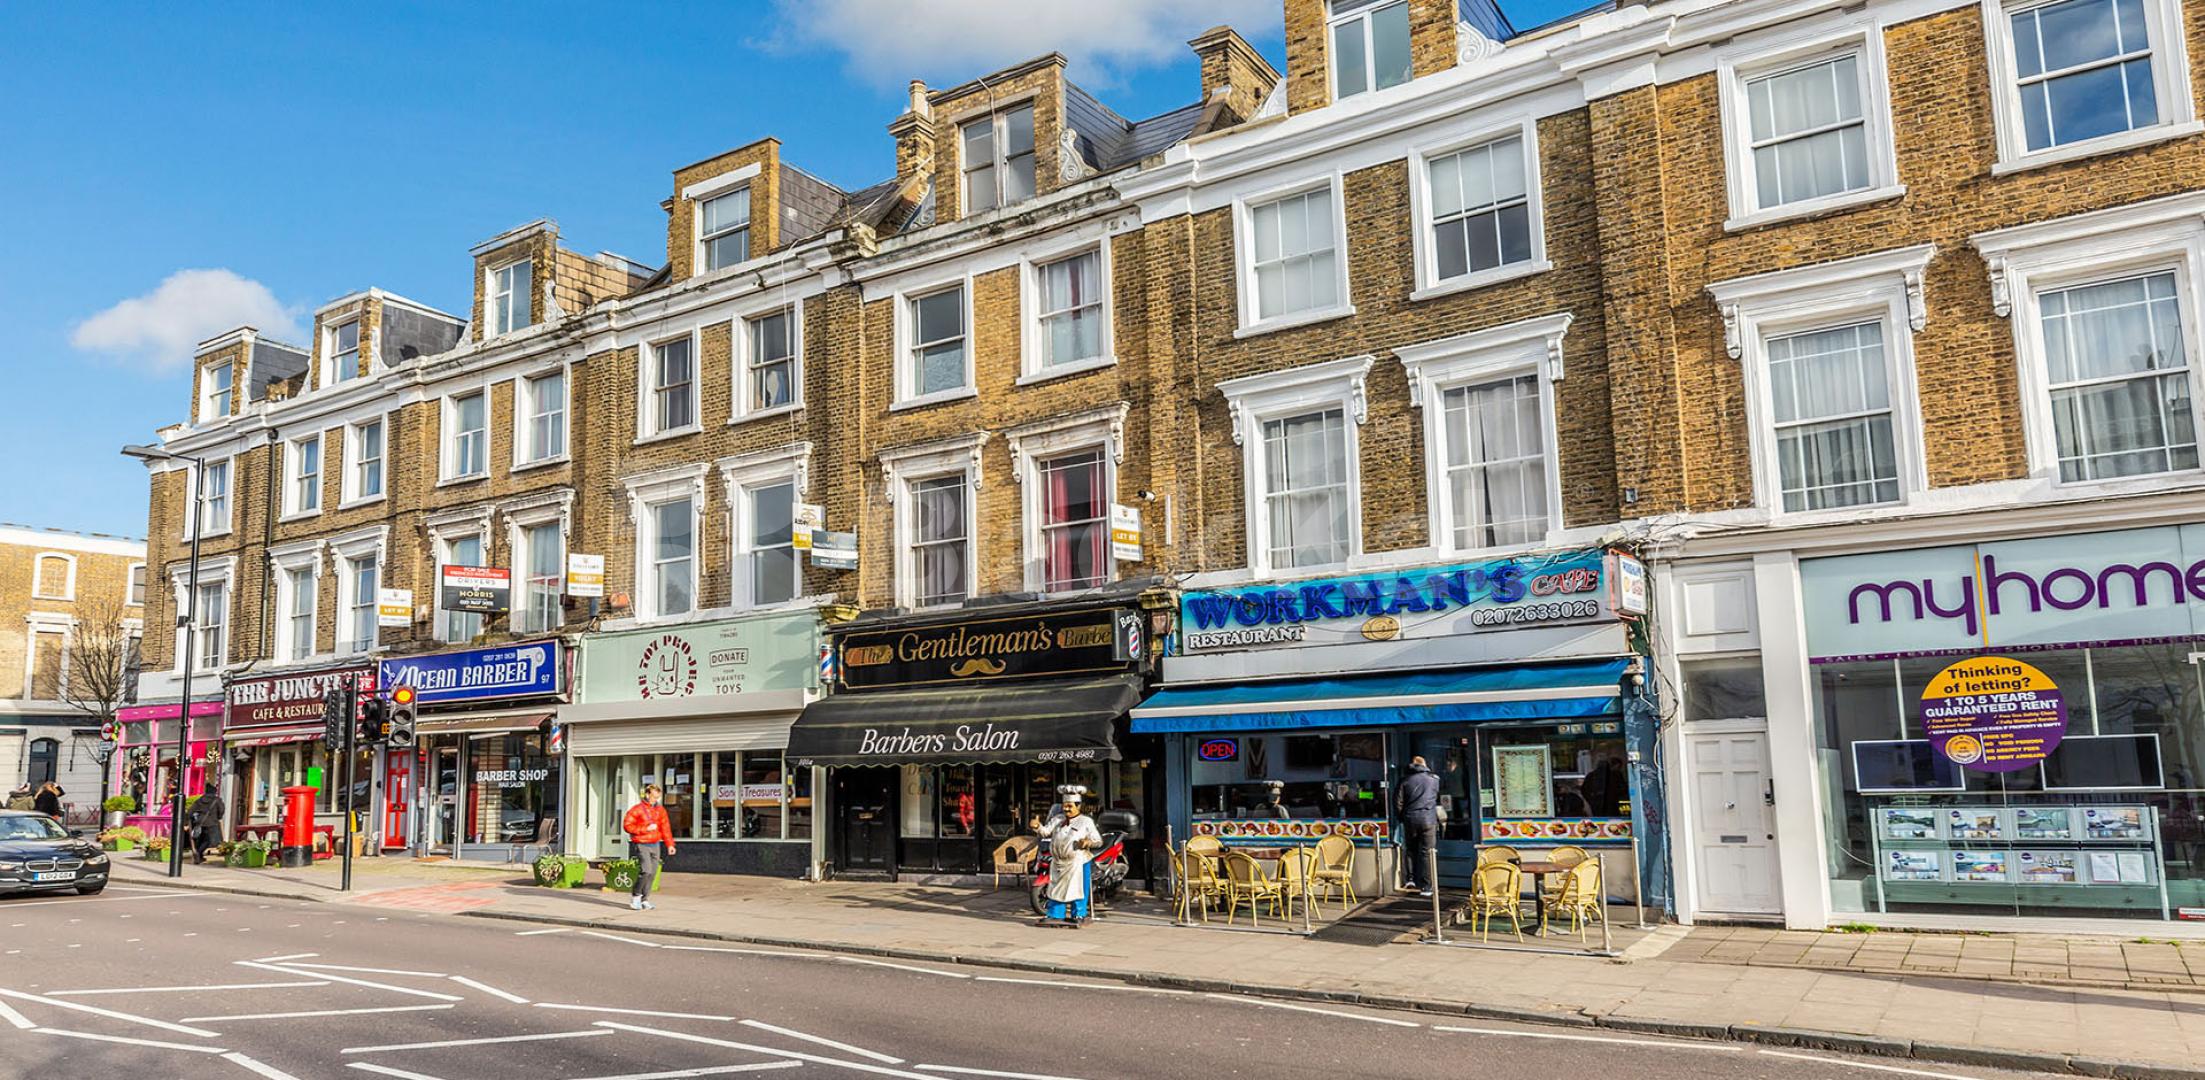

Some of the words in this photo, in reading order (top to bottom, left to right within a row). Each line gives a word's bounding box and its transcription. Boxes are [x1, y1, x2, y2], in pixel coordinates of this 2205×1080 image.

[1185, 564, 1528, 631] WORKMAN'S
[1472, 600, 1598, 628] 02072633026
[898, 620, 1053, 662] Gentleman's
[1188, 624, 1306, 650] RESTAURANT
[712, 652, 746, 664] DONATE
[1825, 655, 1876, 663] SALES
[406, 666, 457, 691] OCEAN
[461, 661, 527, 688] BARBER
[1947, 664, 2023, 681] Thinking
[231, 681, 271, 706] THE
[716, 683, 742, 695] TOYS
[1943, 681, 1960, 695] of
[1966, 677, 2031, 694] letting?
[1956, 696, 1975, 706] TO
[1978, 695, 1988, 704] 5
[1990, 691, 2037, 703] YEARS
[253, 708, 275, 721] CAFE
[1925, 701, 2018, 718] GUARANTEED
[2021, 699, 2059, 711] RENT
[858, 728, 946, 755] Barbers
[951, 723, 1021, 752] Salon
[1201, 740, 1235, 759] OPEN
[475, 769, 517, 782] BARBER
[518, 769, 549, 781] SHOP
[744, 786, 782, 798] Treasures
